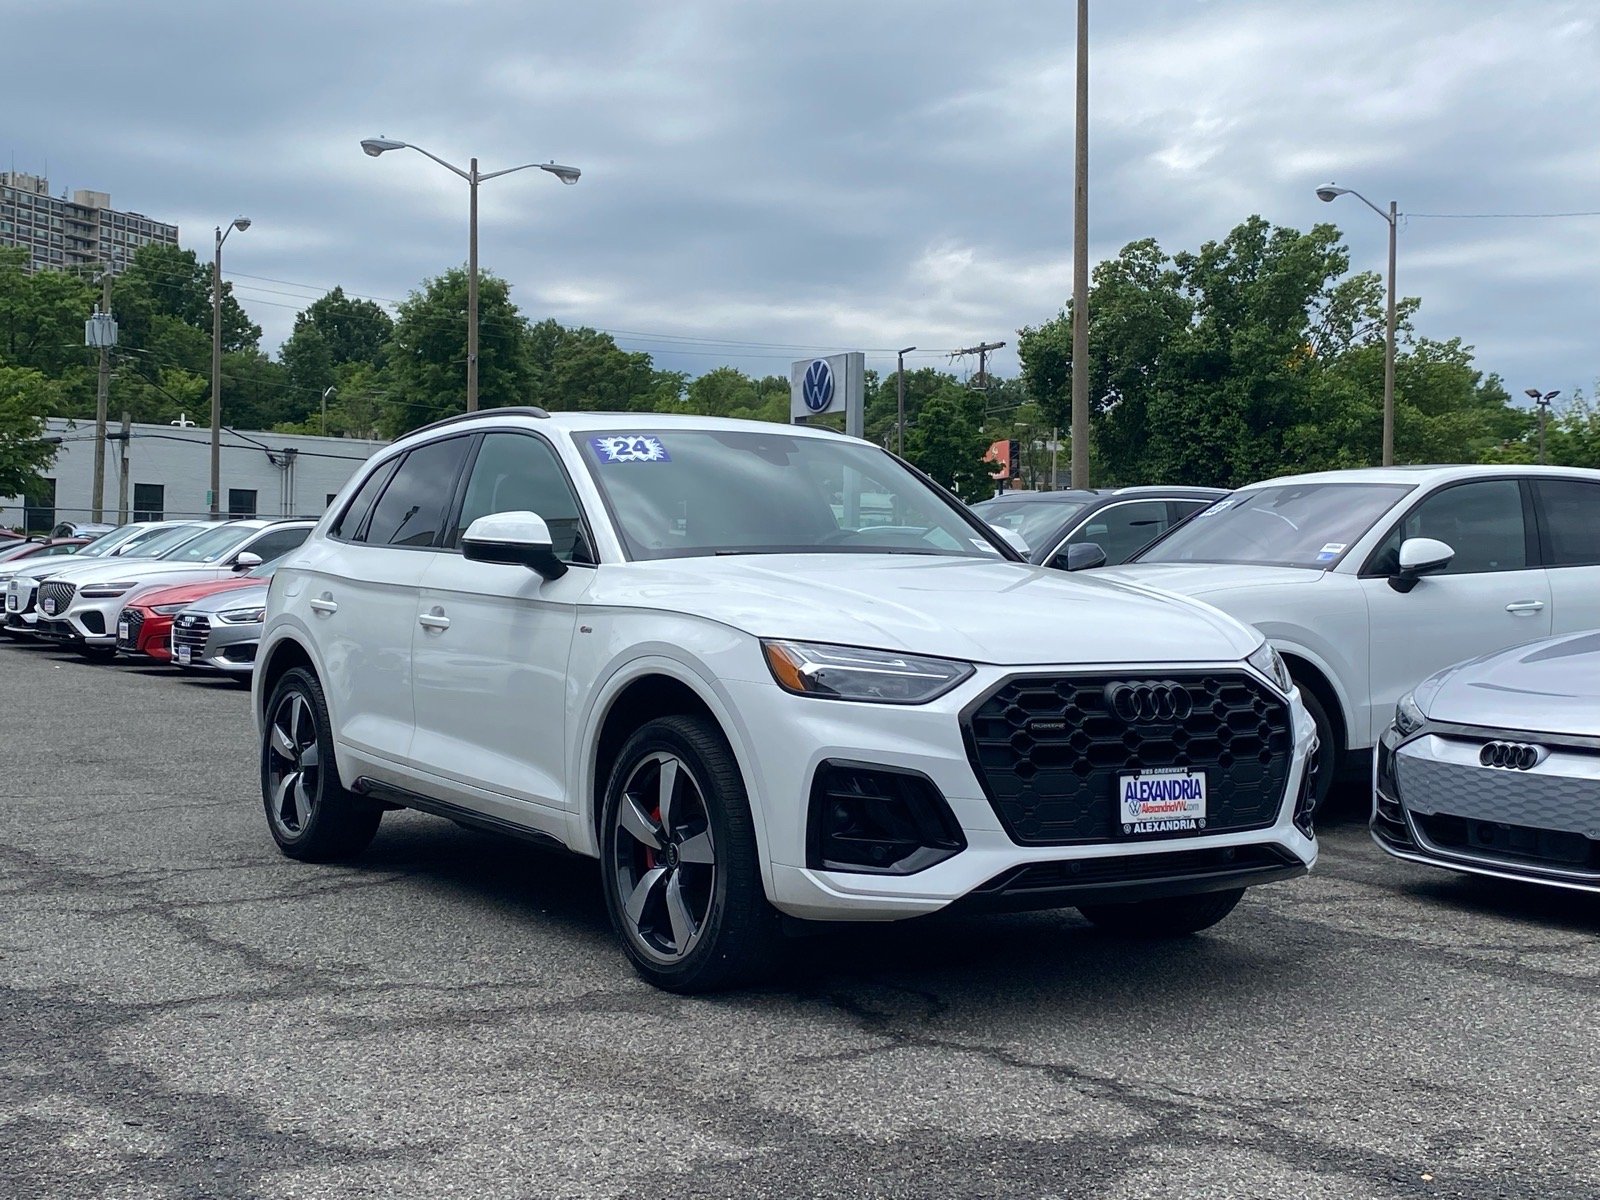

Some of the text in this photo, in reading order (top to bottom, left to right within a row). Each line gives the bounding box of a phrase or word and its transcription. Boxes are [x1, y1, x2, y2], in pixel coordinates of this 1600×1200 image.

[803, 358, 833, 413] VW
[613, 440, 650, 455] 24
[1124, 779, 1202, 803] ALEXANDRIA
[1133, 819, 1197, 834] ALEXANDRIA
